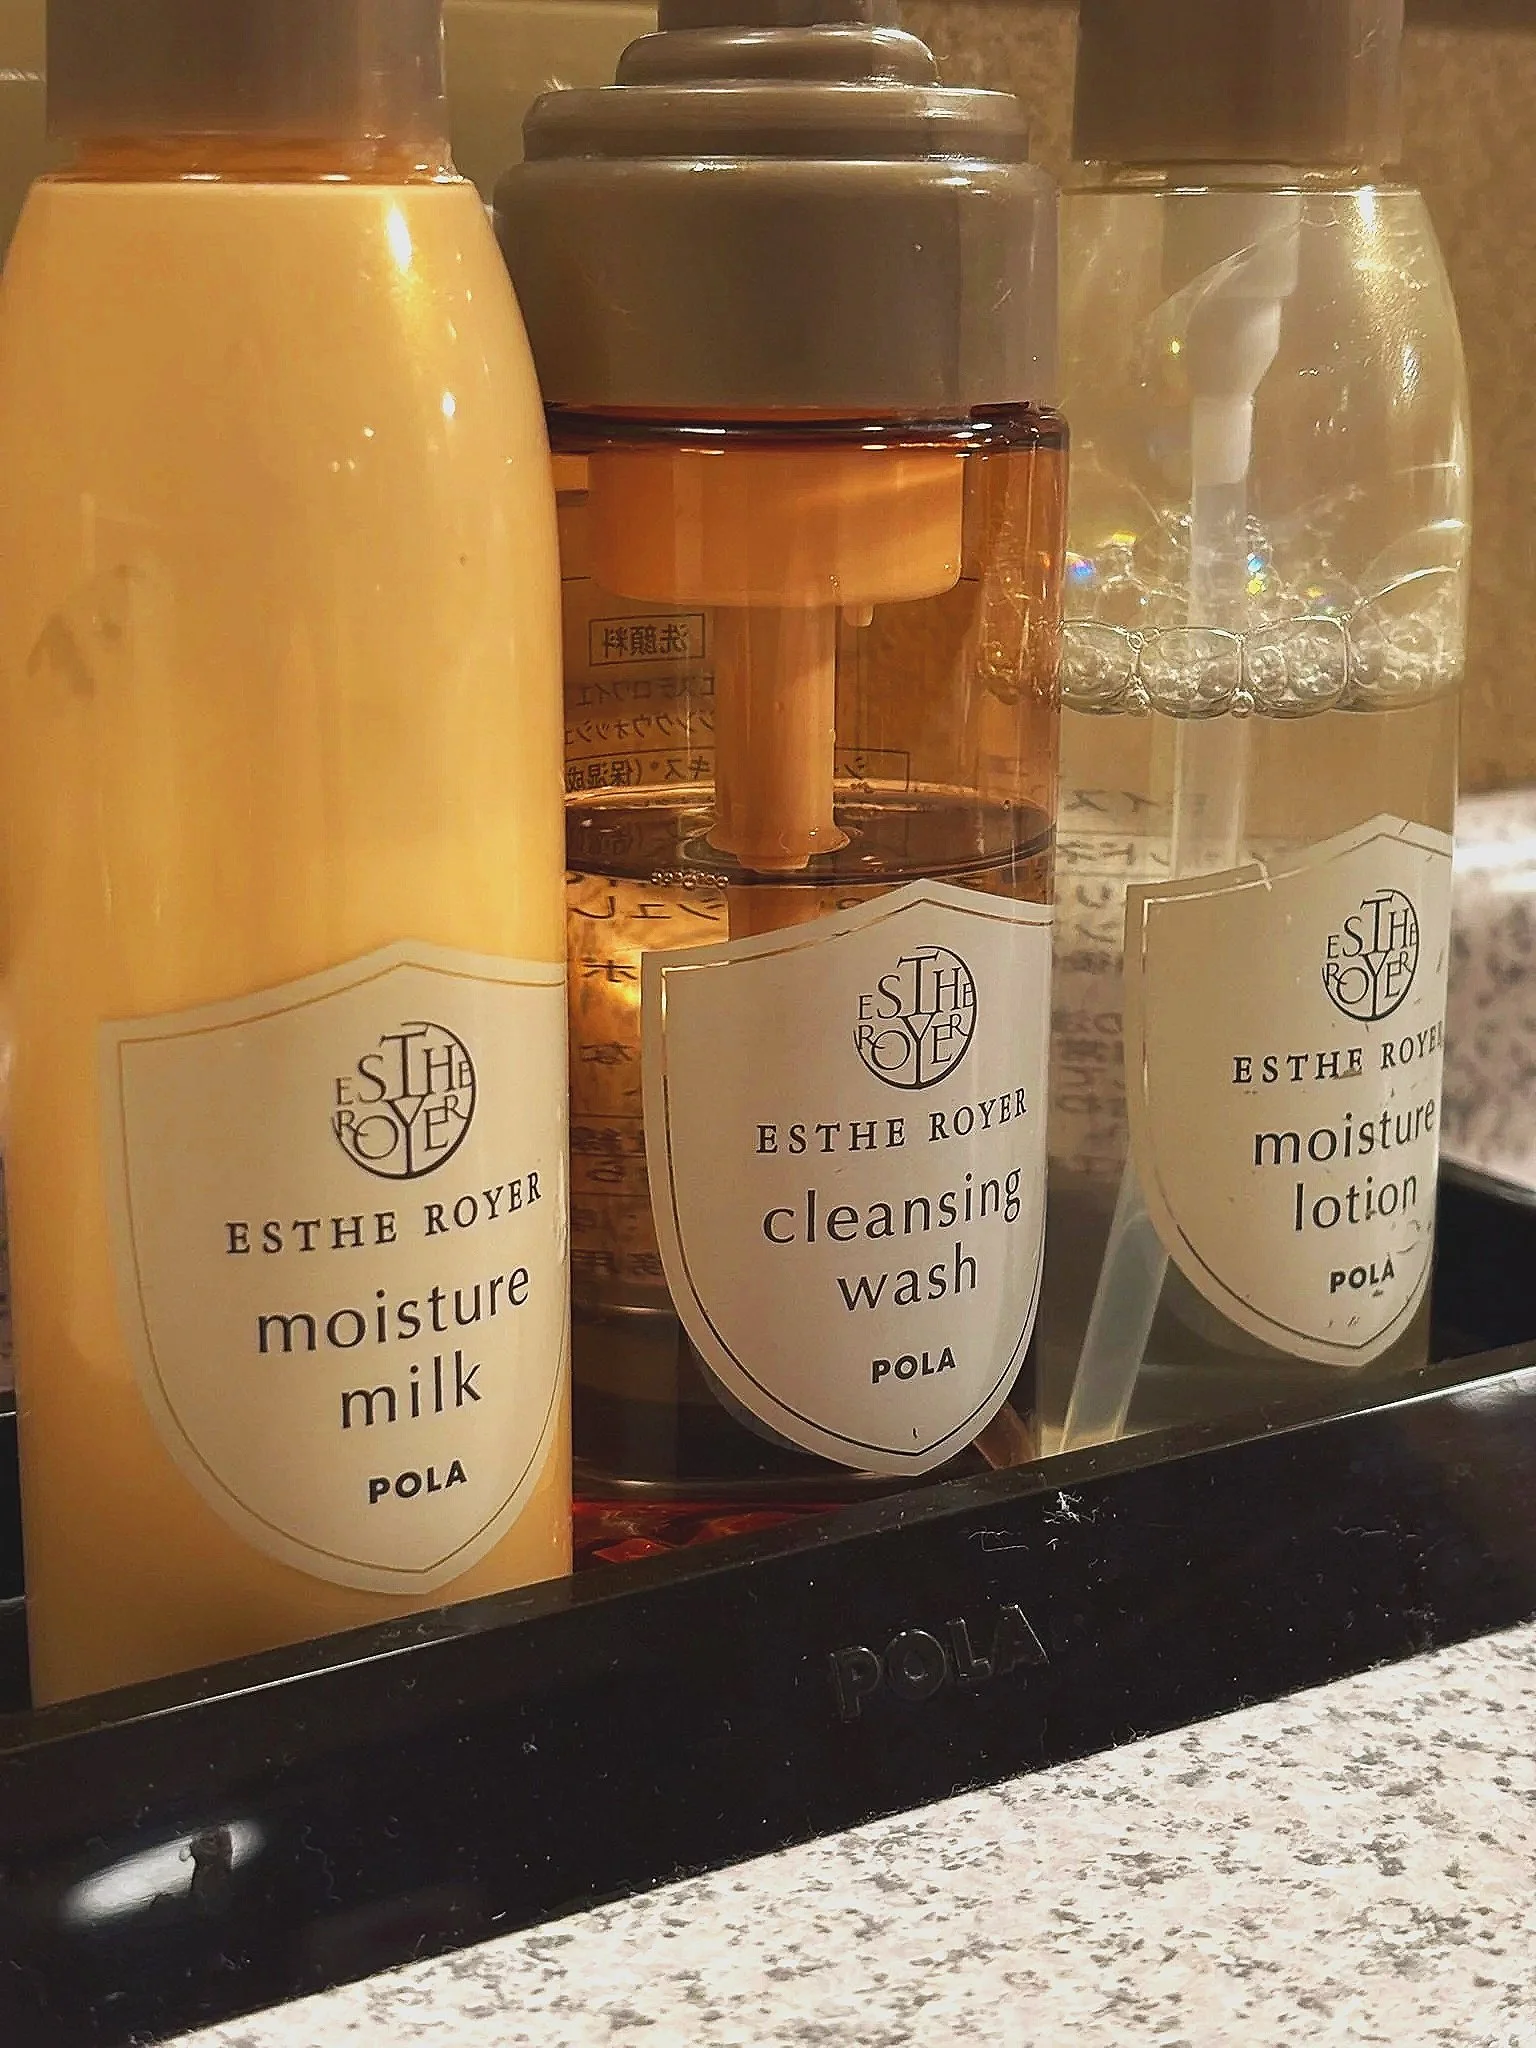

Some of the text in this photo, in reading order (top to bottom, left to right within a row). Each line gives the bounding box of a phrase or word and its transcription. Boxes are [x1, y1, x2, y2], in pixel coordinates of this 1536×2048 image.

[858, 946, 975, 1020] ESTHE
[335, 1021, 476, 1106] ESTHE
[854, 1011, 969, 1089] ROYER
[1232, 1047, 1363, 1084] ESTHE
[331, 1095, 469, 1177] ROYER
[755, 1117, 905, 1155] ESTHE
[927, 1087, 1027, 1142] ROYER
[1254, 1098, 1435, 1166] moisture
[226, 1210, 396, 1255] ESTHE
[424, 1169, 544, 1237] ROYER
[762, 1166, 1023, 1244] cleansing
[1295, 1173, 1417, 1232] lotion
[257, 1265, 530, 1354] moisture
[836, 1242, 979, 1312] wash
[1329, 1257, 1396, 1294] POLA
[340, 1349, 482, 1430] milk
[871, 1347, 956, 1384] POLA
[367, 1459, 468, 1505] POLA
[828, 1604, 1050, 1724] POLA
